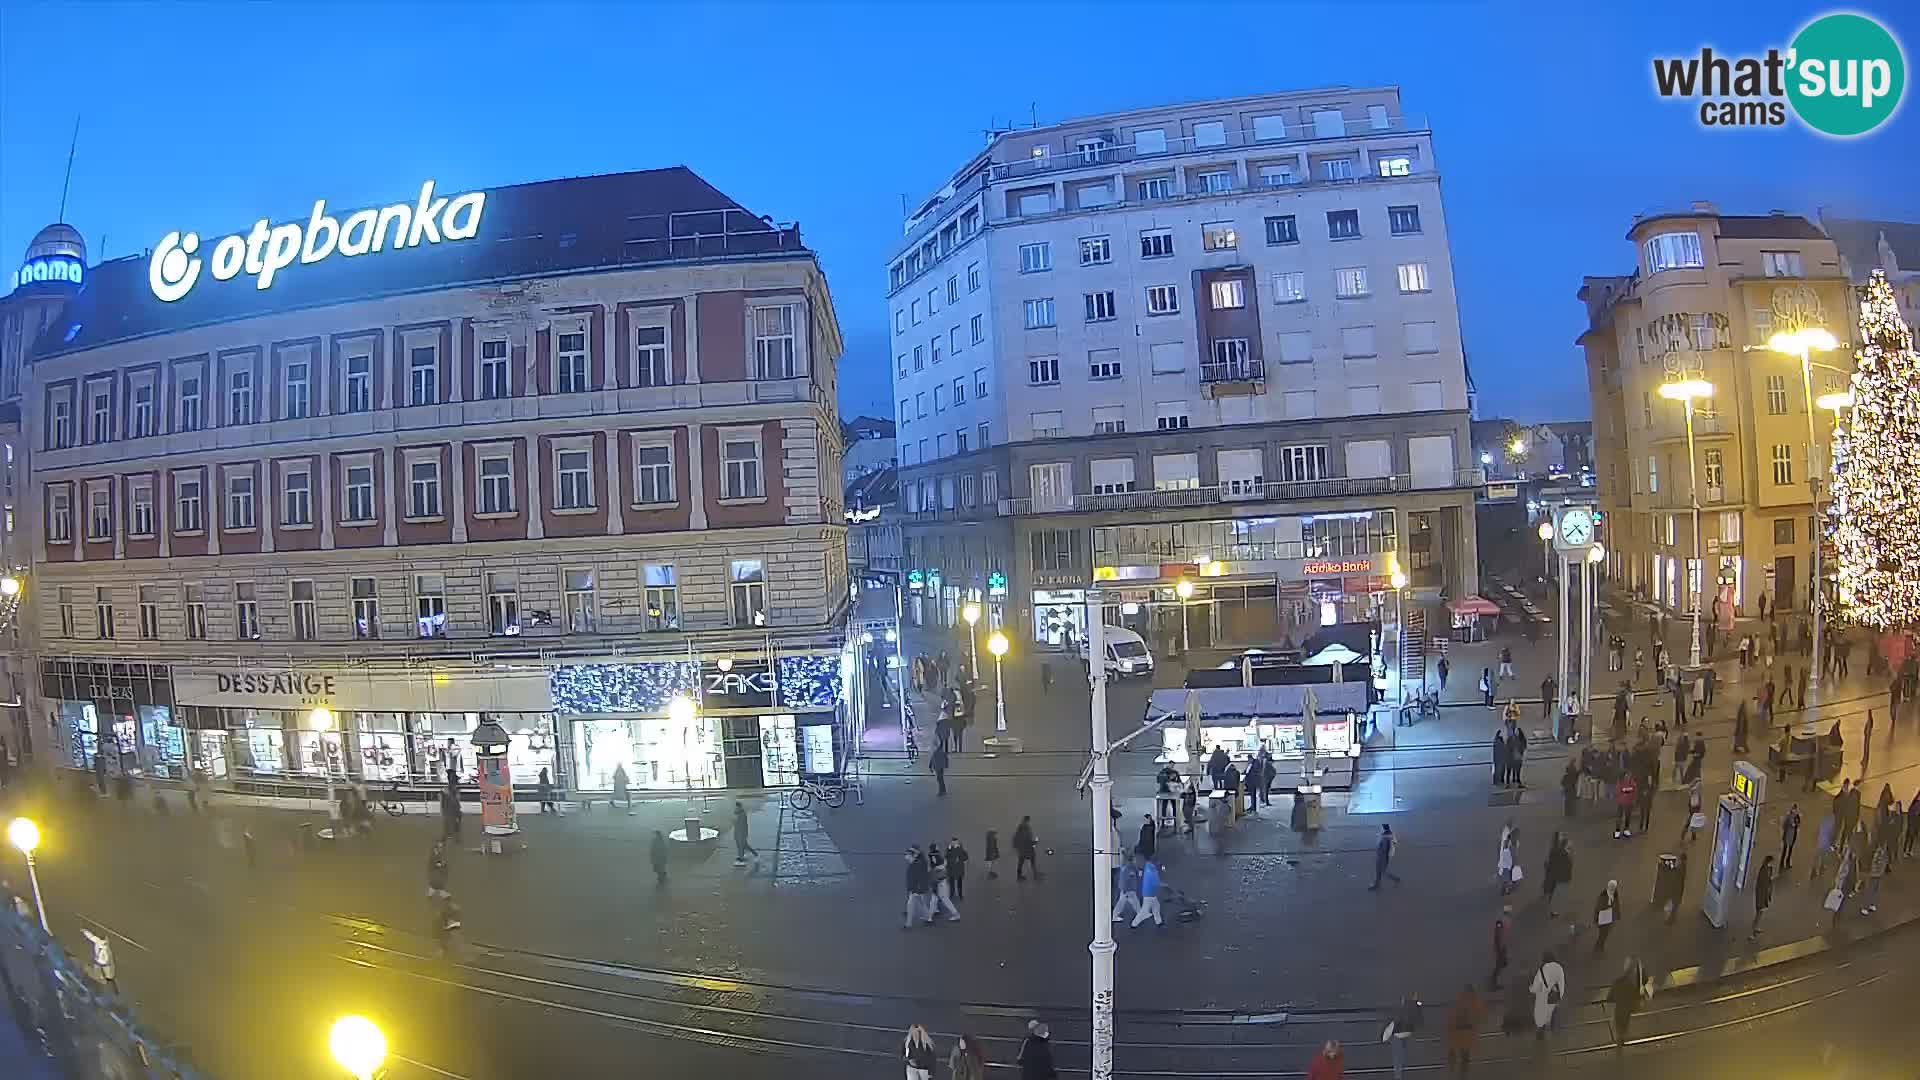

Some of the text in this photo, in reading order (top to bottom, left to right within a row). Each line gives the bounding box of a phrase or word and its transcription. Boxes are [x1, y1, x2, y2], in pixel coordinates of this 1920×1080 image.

[1304, 560, 1370, 574] Addiko Bank
[1033, 575, 1082, 584] LJKARNA
[218, 673, 336, 695] DESSANGE
[704, 672, 778, 694] ZAKS
